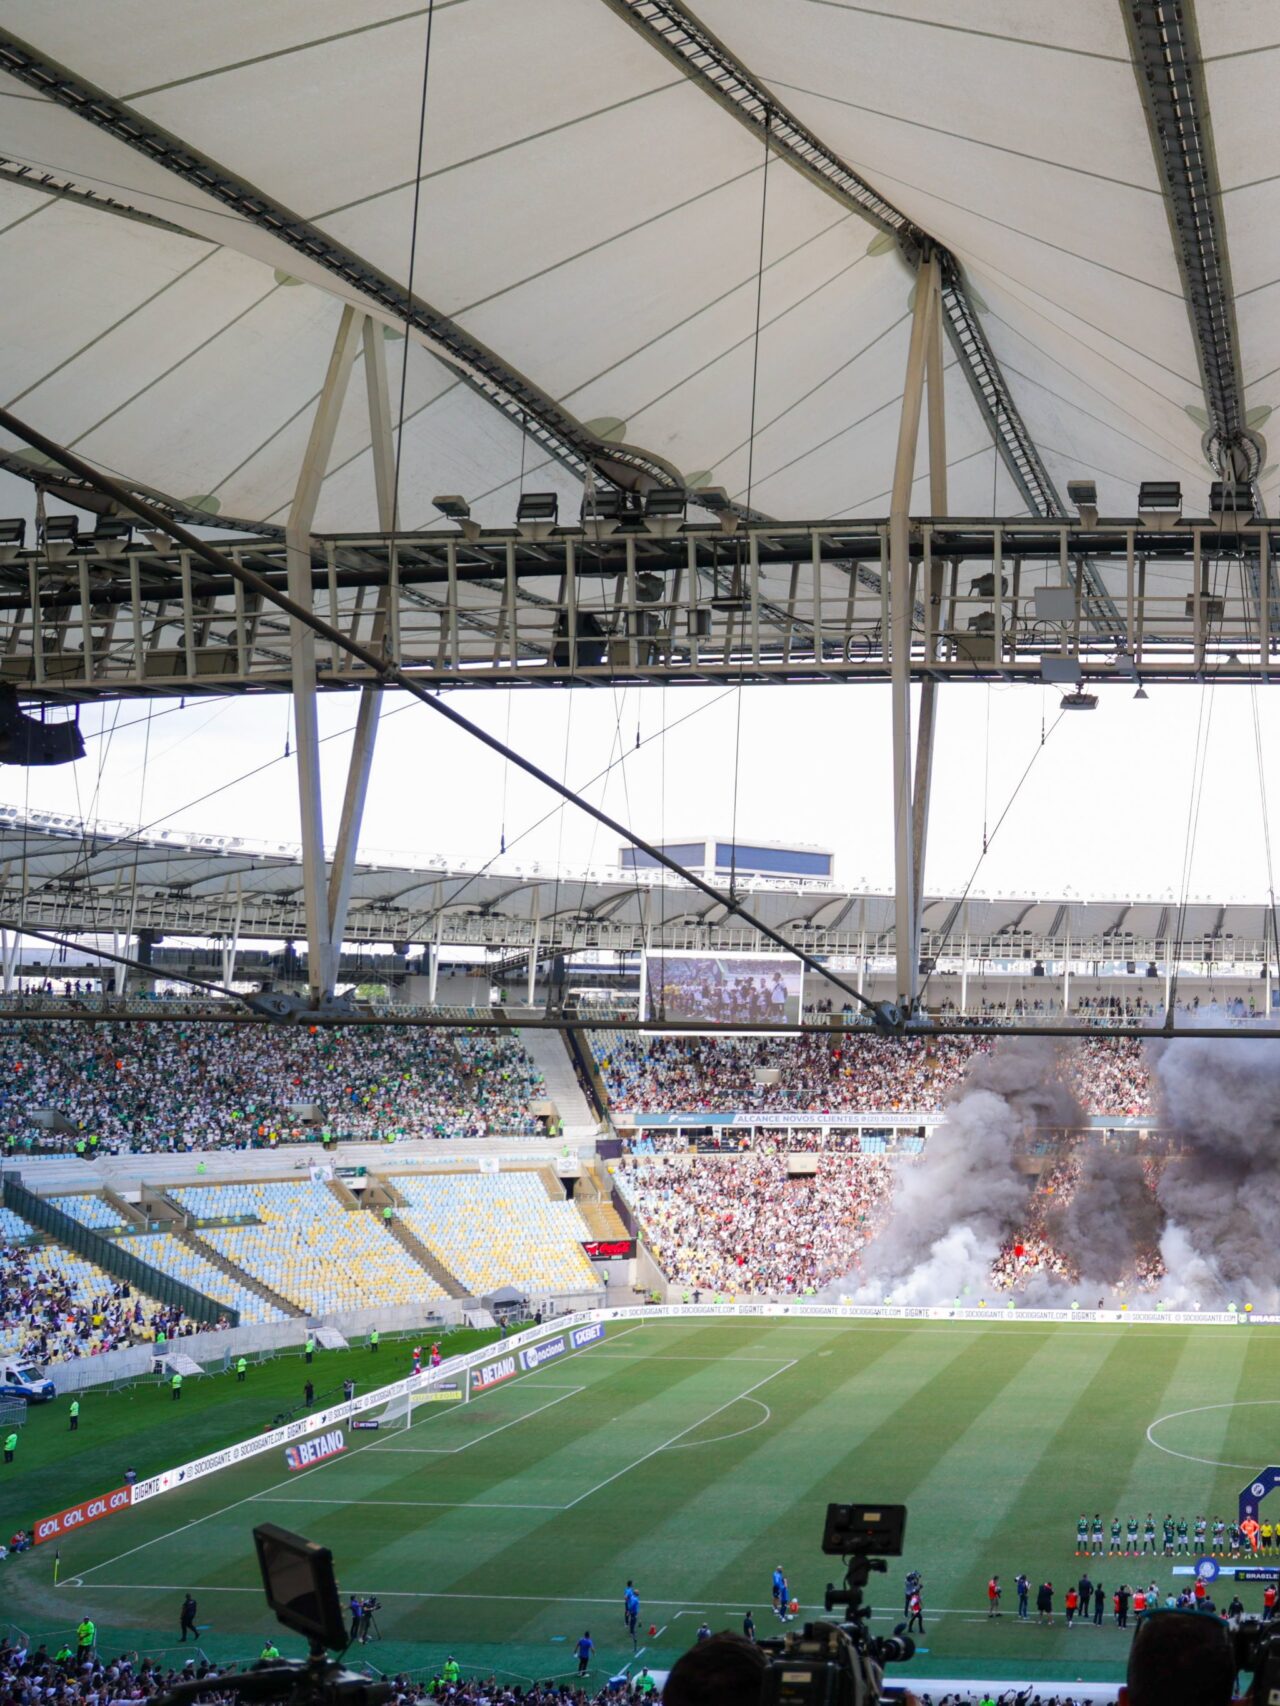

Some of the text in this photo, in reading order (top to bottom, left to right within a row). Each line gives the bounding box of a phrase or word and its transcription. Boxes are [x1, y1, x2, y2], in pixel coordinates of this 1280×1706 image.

[737, 1115, 782, 1123] ALCANCE
[782, 1115, 815, 1123] NOVOS
[817, 1115, 860, 1123] CLIENTES
[738, 1305, 764, 1315] GIGANTE
[904, 1309, 930, 1318] GIGANTE
[1071, 1311, 1097, 1321] GIGANTE
[482, 1356, 515, 1385] BETANO
[135, 1478, 160, 1500] GIGANTE
[194, 1450, 232, 1476] SOCIOGIGANTE
[240, 1431, 285, 1460] SOCIOGIGANTE.COM
[287, 1420, 307, 1439] GIGANTE
[299, 1429, 344, 1465] BETANO
[39, 1490, 130, 1538] GOL GOL GOL GOL
